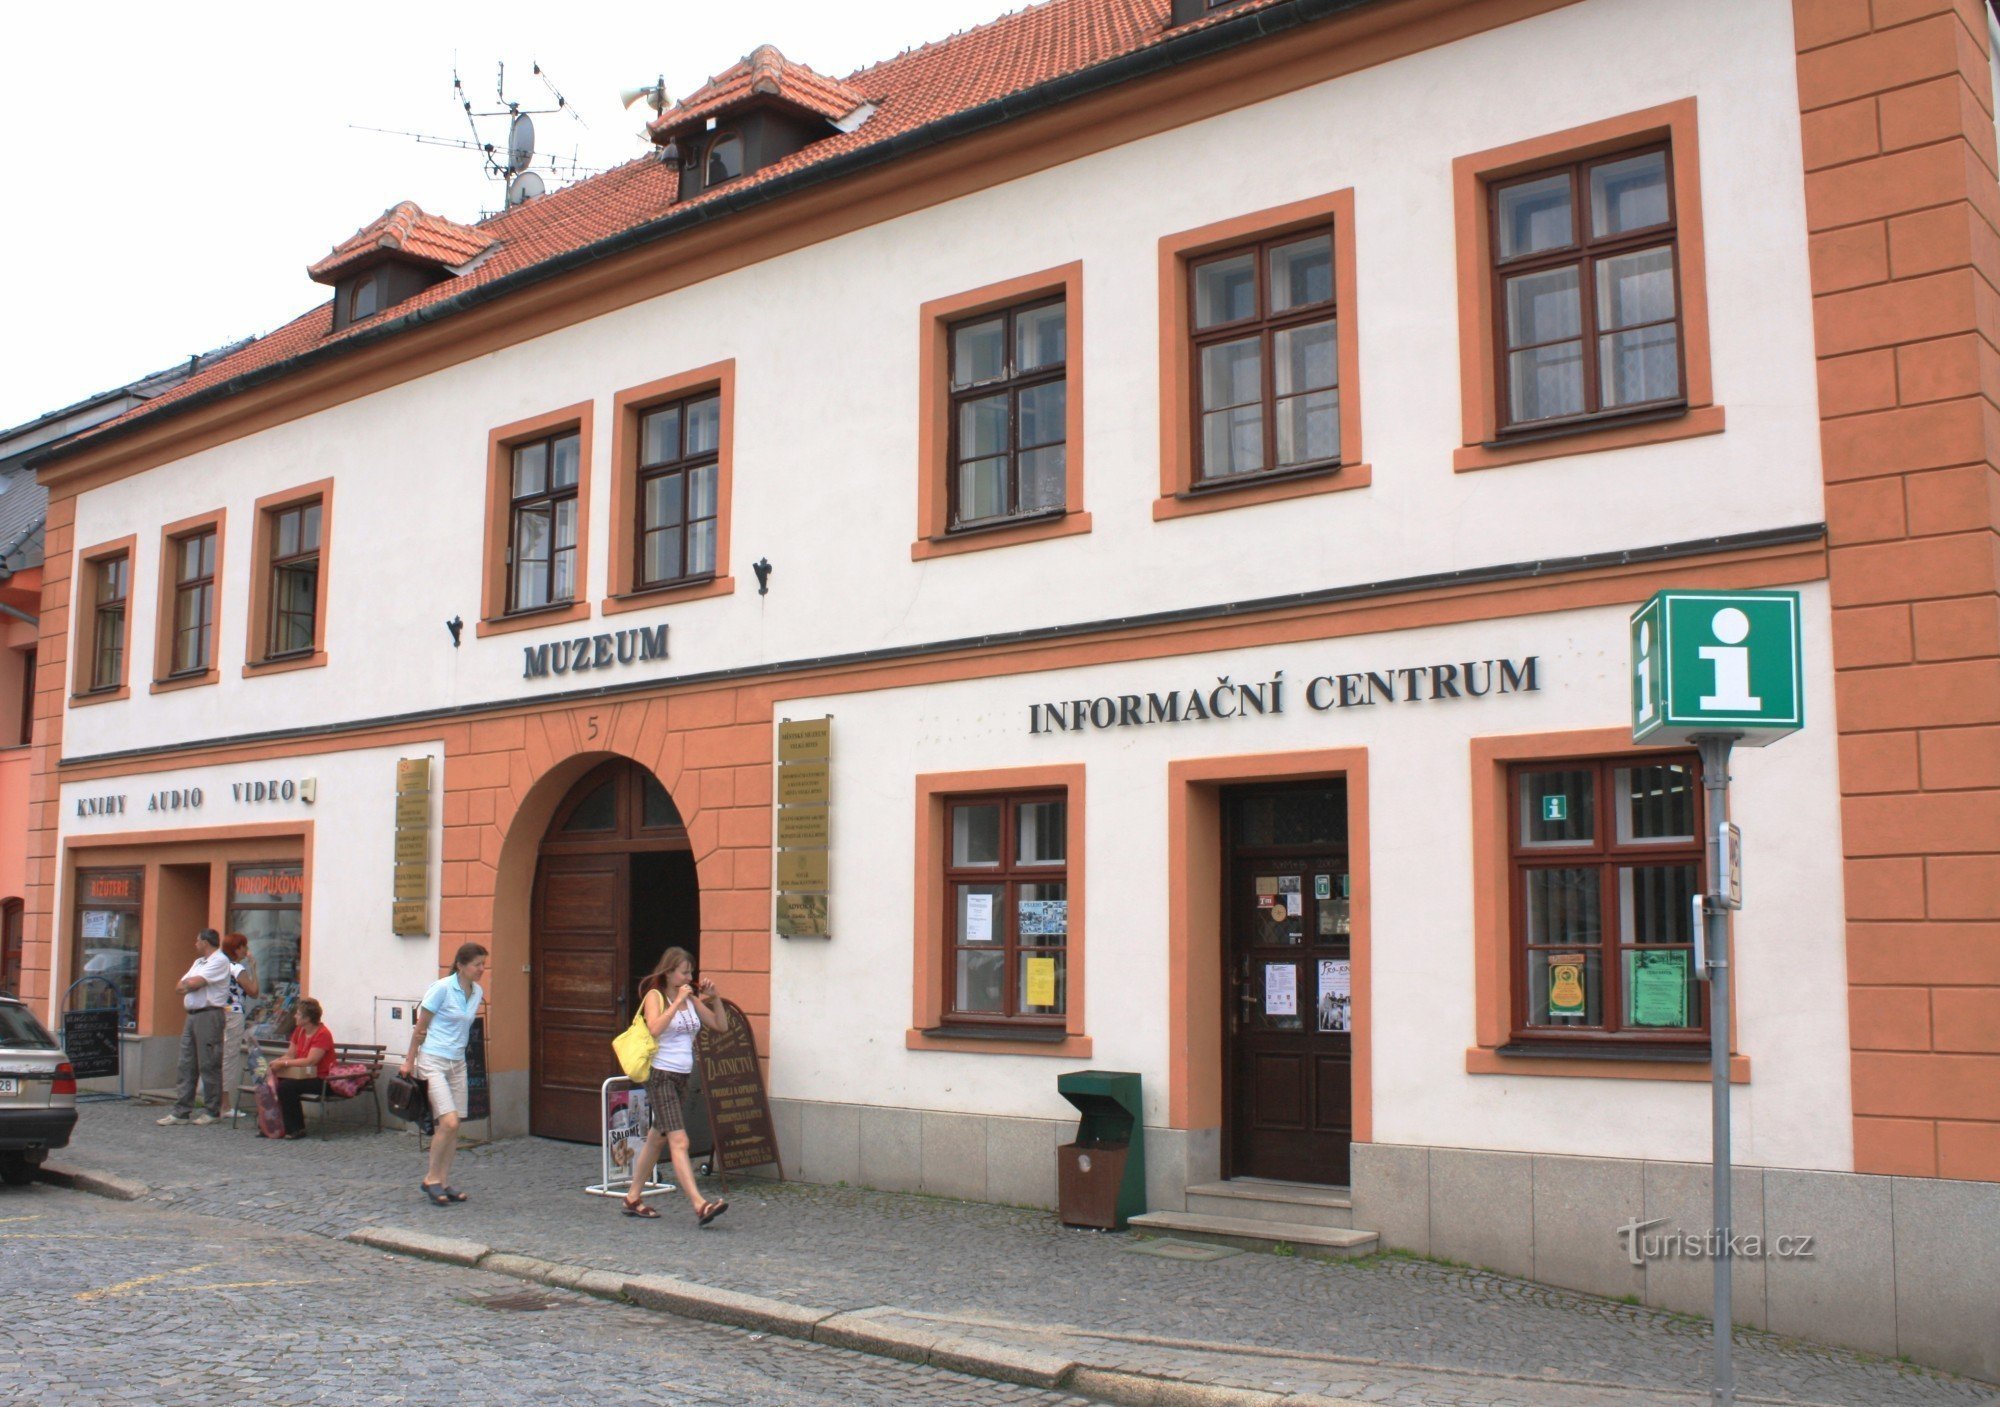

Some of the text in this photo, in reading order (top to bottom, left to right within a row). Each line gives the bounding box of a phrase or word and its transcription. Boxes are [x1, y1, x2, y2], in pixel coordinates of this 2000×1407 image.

[523, 624, 670, 679] MUZEUM
[1028, 656, 1540, 734] INFORMAČNÍ CENTRUM
[588, 716, 599, 741] 5
[77, 779, 295, 816] KNIHY AUDIO VIDEO
[704, 1051, 755, 1081] ZLATNICTVÍ
